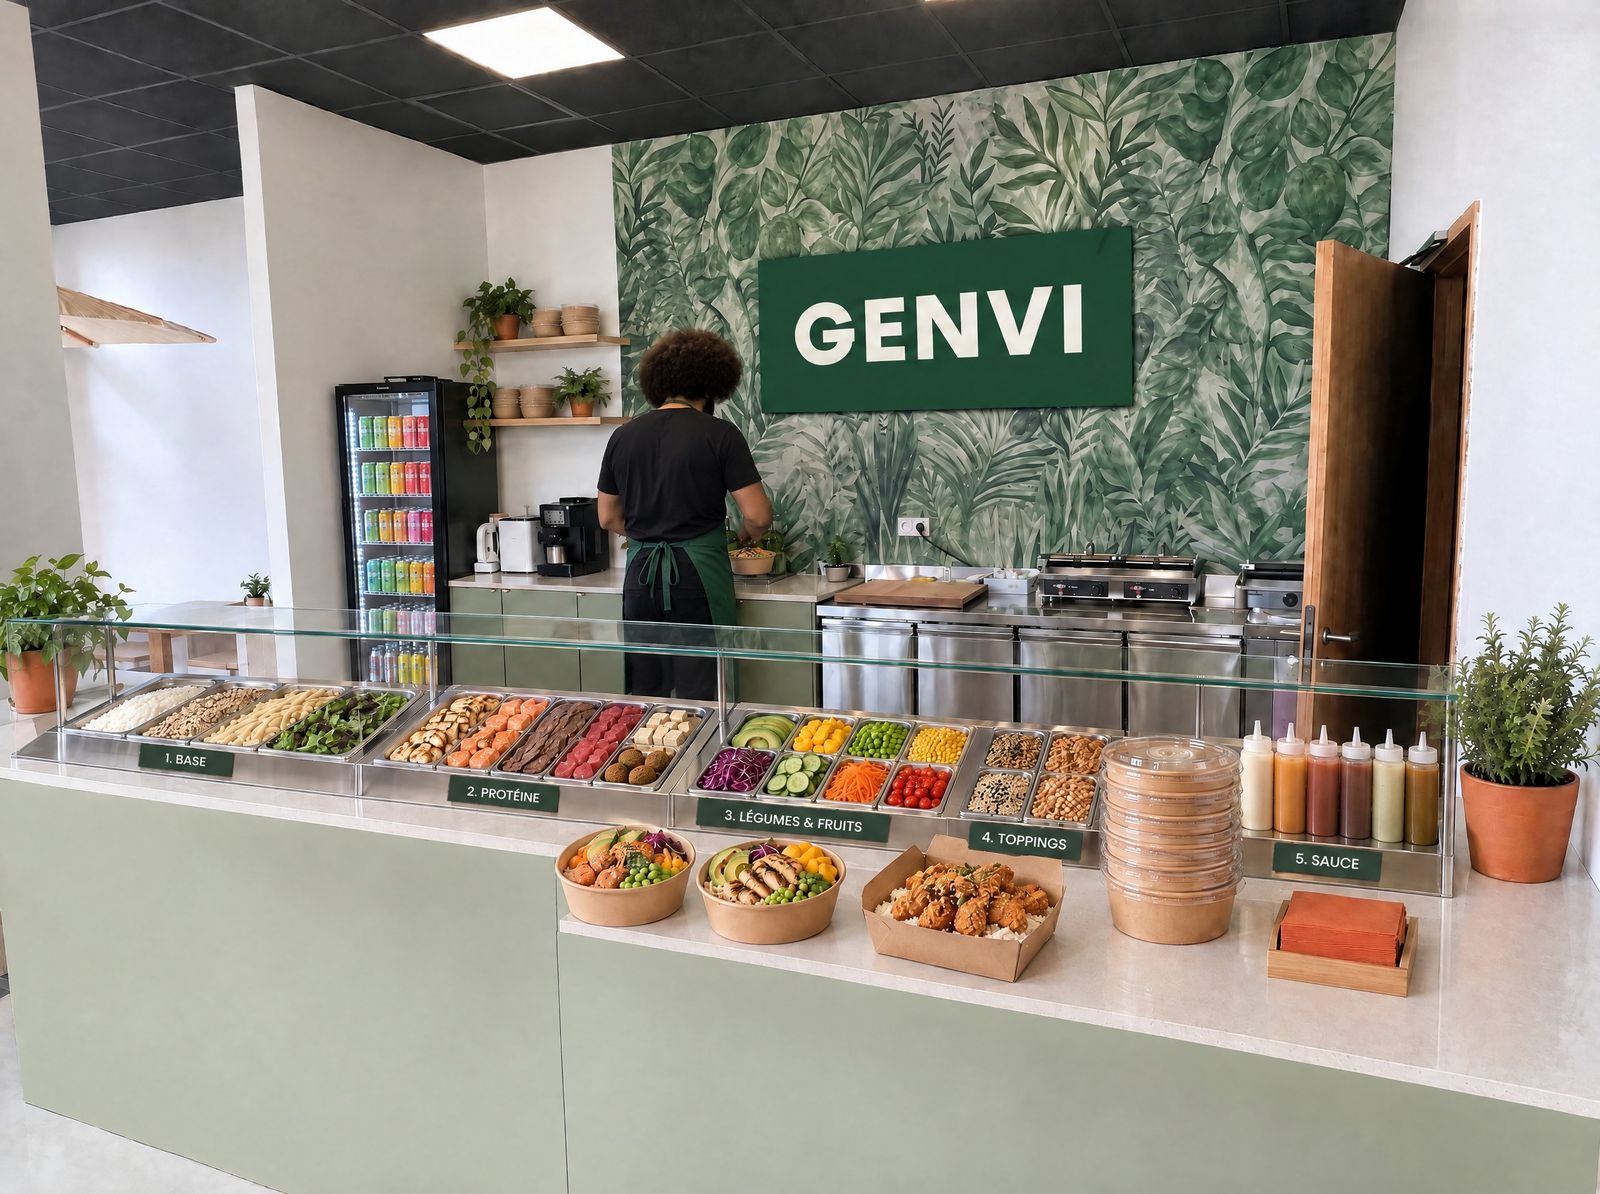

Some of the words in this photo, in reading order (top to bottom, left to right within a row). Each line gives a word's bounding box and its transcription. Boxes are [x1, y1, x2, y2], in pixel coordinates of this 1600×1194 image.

[794, 284, 1083, 366] GENVI
[166, 753, 173, 764] 1.
[176, 754, 207, 767] BASE
[467, 785, 479, 798] 2.
[481, 786, 540, 803] PROTÉINE
[724, 809, 736, 822] 3.
[739, 809, 801, 827] LÉGUMES
[803, 816, 815, 829] &
[817, 818, 863, 833] FRUITS
[982, 831, 994, 843] 4.
[998, 832, 1067, 851] TOPPINGS
[1295, 852, 1308, 865] 5.
[1311, 854, 1360, 870] SAUCE
